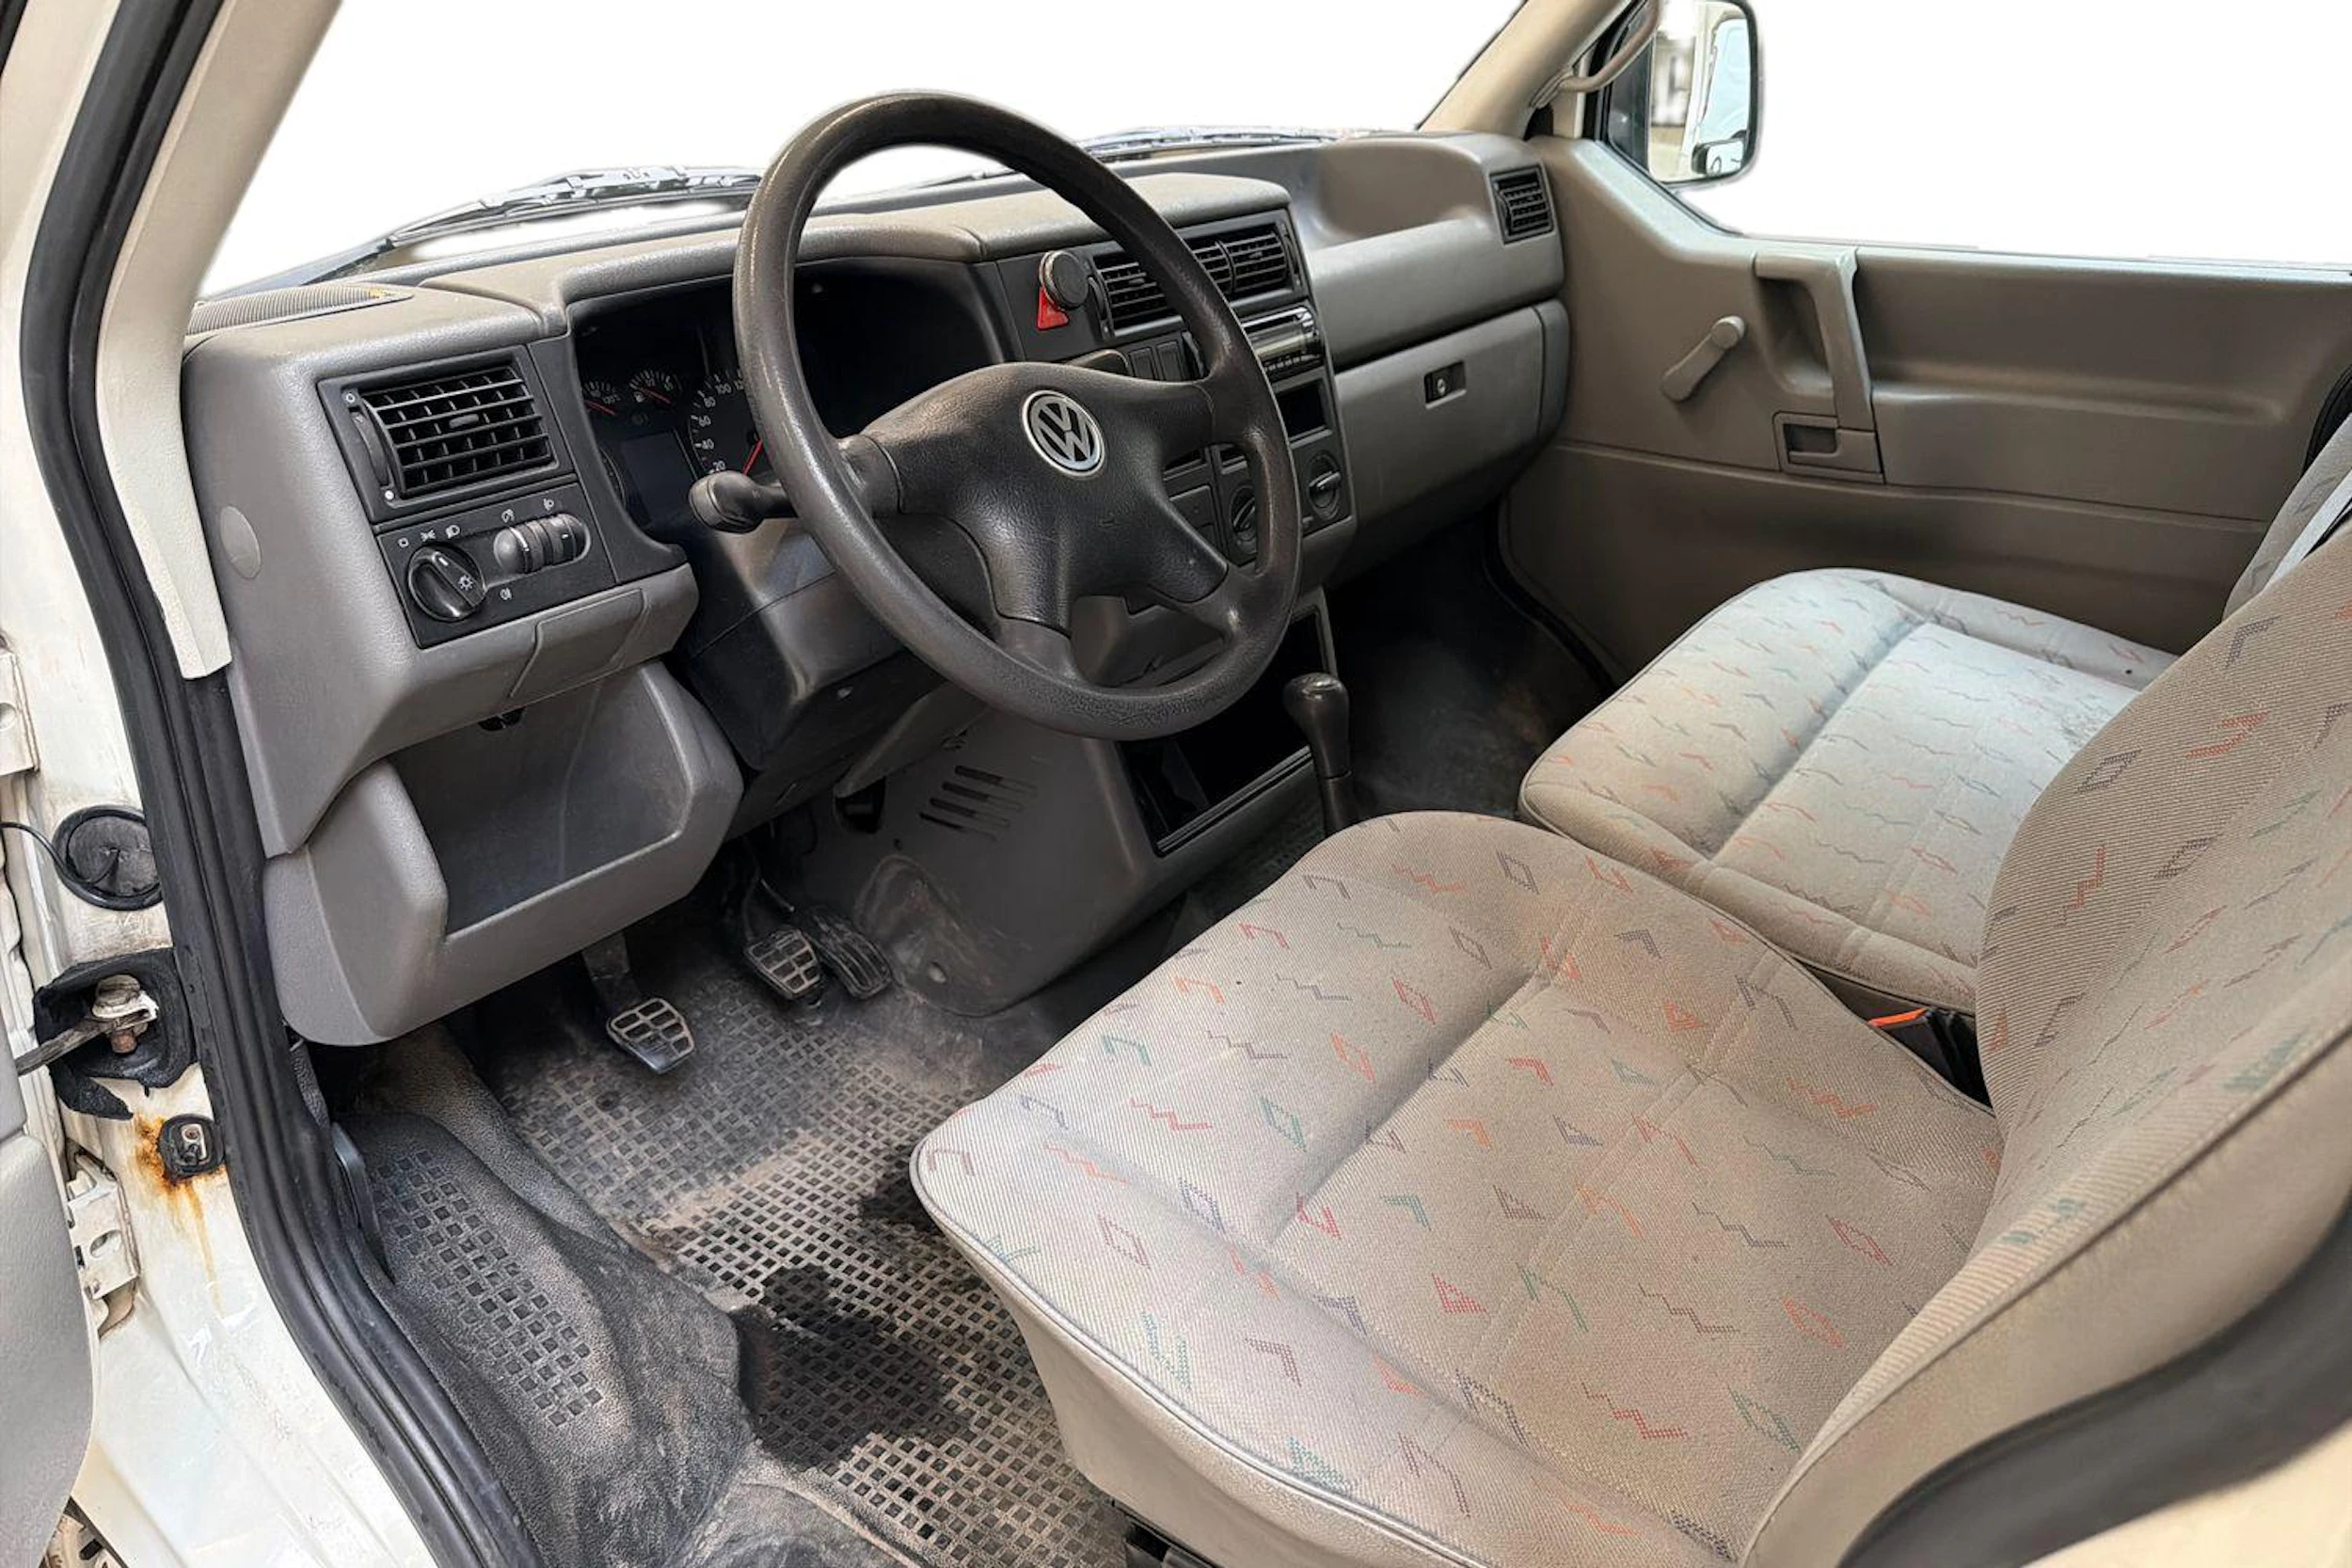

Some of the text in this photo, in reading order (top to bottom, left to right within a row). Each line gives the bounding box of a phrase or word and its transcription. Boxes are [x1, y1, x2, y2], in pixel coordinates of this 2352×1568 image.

[715, 383, 732, 395] 100
[704, 396, 716, 408] 80
[698, 415, 711, 427] 60
[1028, 394, 1103, 471] VW
[702, 438, 715, 451] 40
